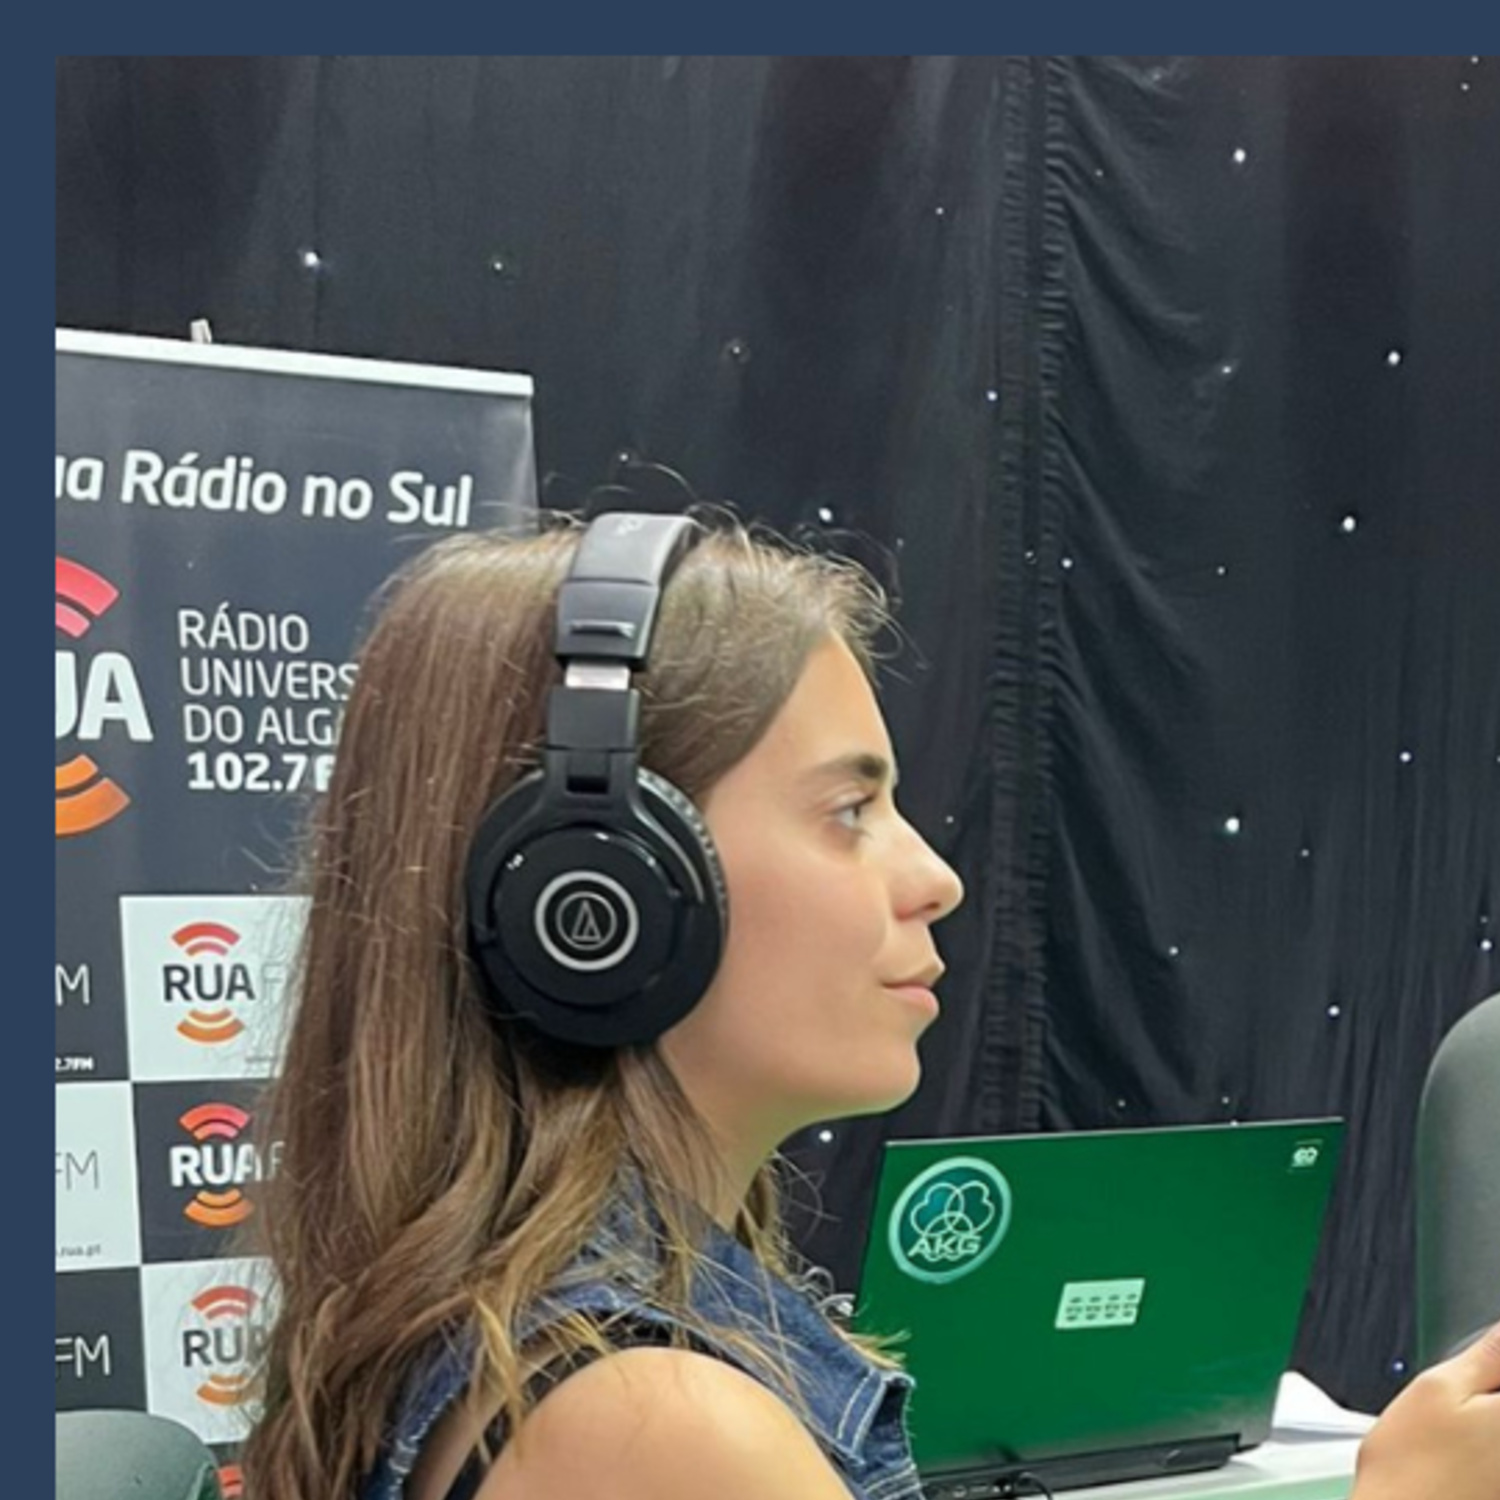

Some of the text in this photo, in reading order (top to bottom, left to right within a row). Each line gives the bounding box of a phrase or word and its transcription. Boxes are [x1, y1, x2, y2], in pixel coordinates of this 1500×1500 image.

[55, 450, 472, 527] a Rádio no Sul
[178, 602, 309, 653] RÁDIO
[184, 704, 243, 744] DO
[55, 963, 91, 1006] M
[163, 963, 256, 1002] RUA
[169, 1142, 264, 1187] RUA
[907, 1232, 982, 1259] AKG
